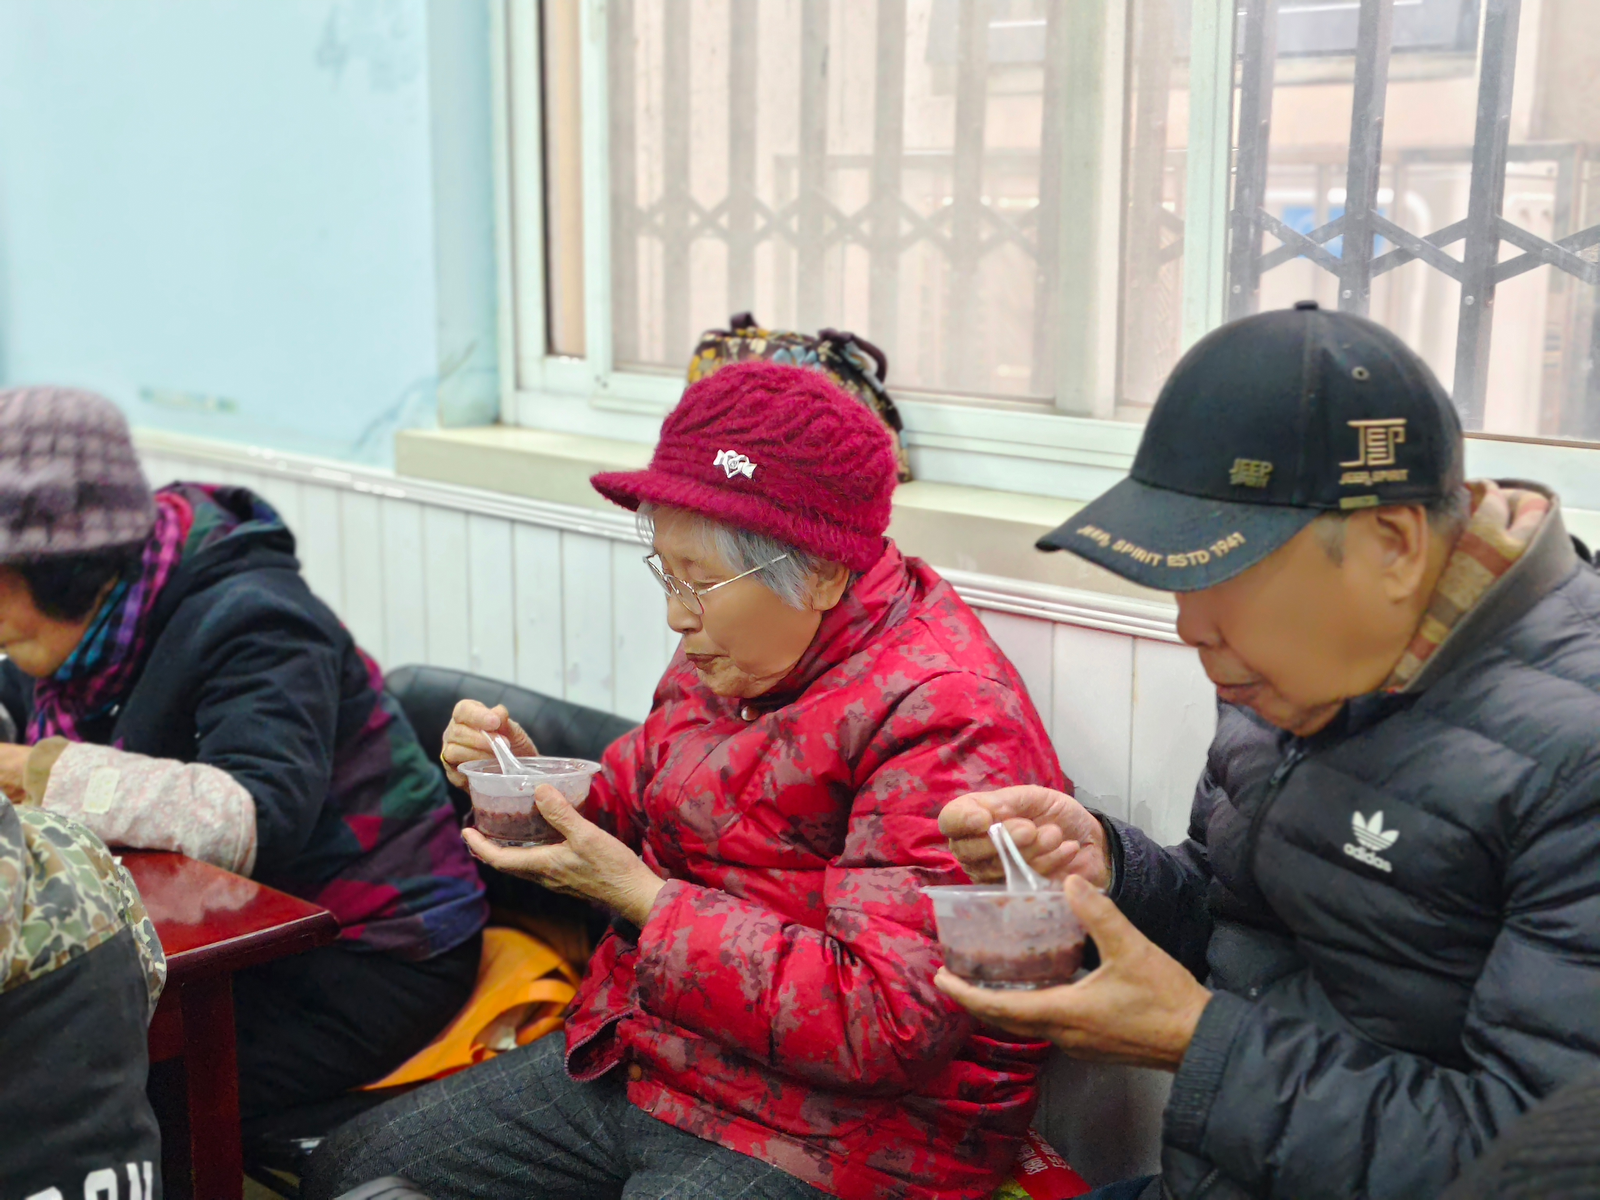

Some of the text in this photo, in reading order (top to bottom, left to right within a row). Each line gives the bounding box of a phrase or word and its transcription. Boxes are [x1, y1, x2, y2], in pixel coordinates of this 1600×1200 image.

[1167, 549, 1210, 567] ESTD
[1210, 532, 1246, 557] 1941
[1343, 843, 1392, 873] adidas
